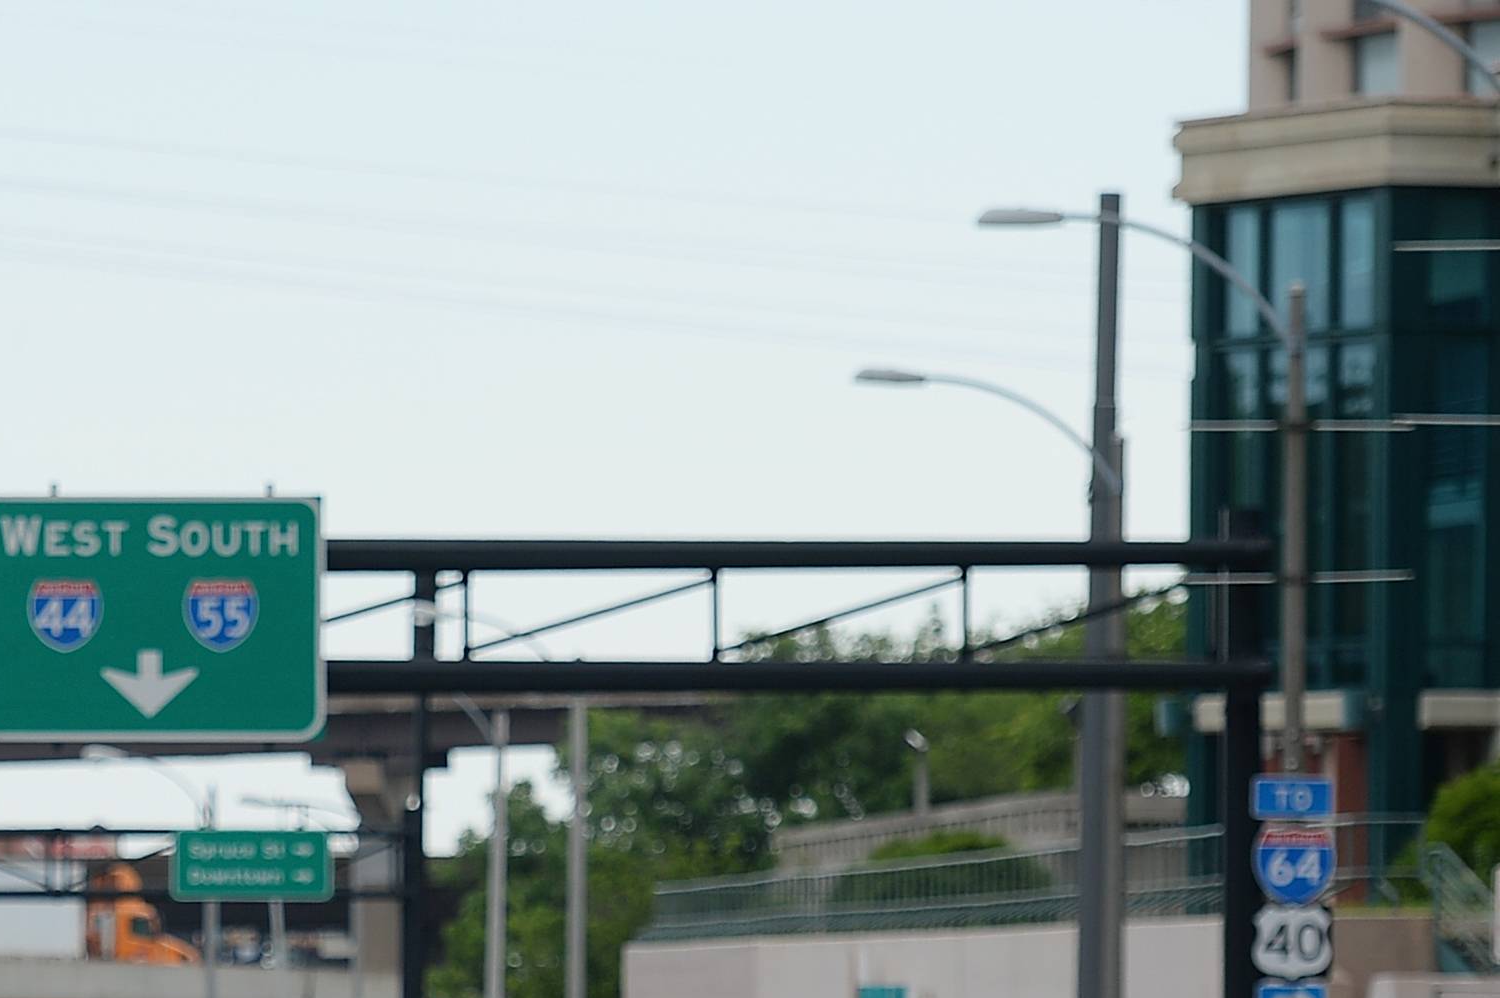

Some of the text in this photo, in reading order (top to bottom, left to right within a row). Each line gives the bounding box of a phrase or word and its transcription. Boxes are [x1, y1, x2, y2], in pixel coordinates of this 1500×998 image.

[0, 514, 299, 557] WEST SOUTH
[36, 598, 93, 638] 44
[199, 598, 250, 638] 55
[1274, 786, 1313, 812] TO
[1267, 848, 1322, 887] 64
[1264, 923, 1324, 962] 40
